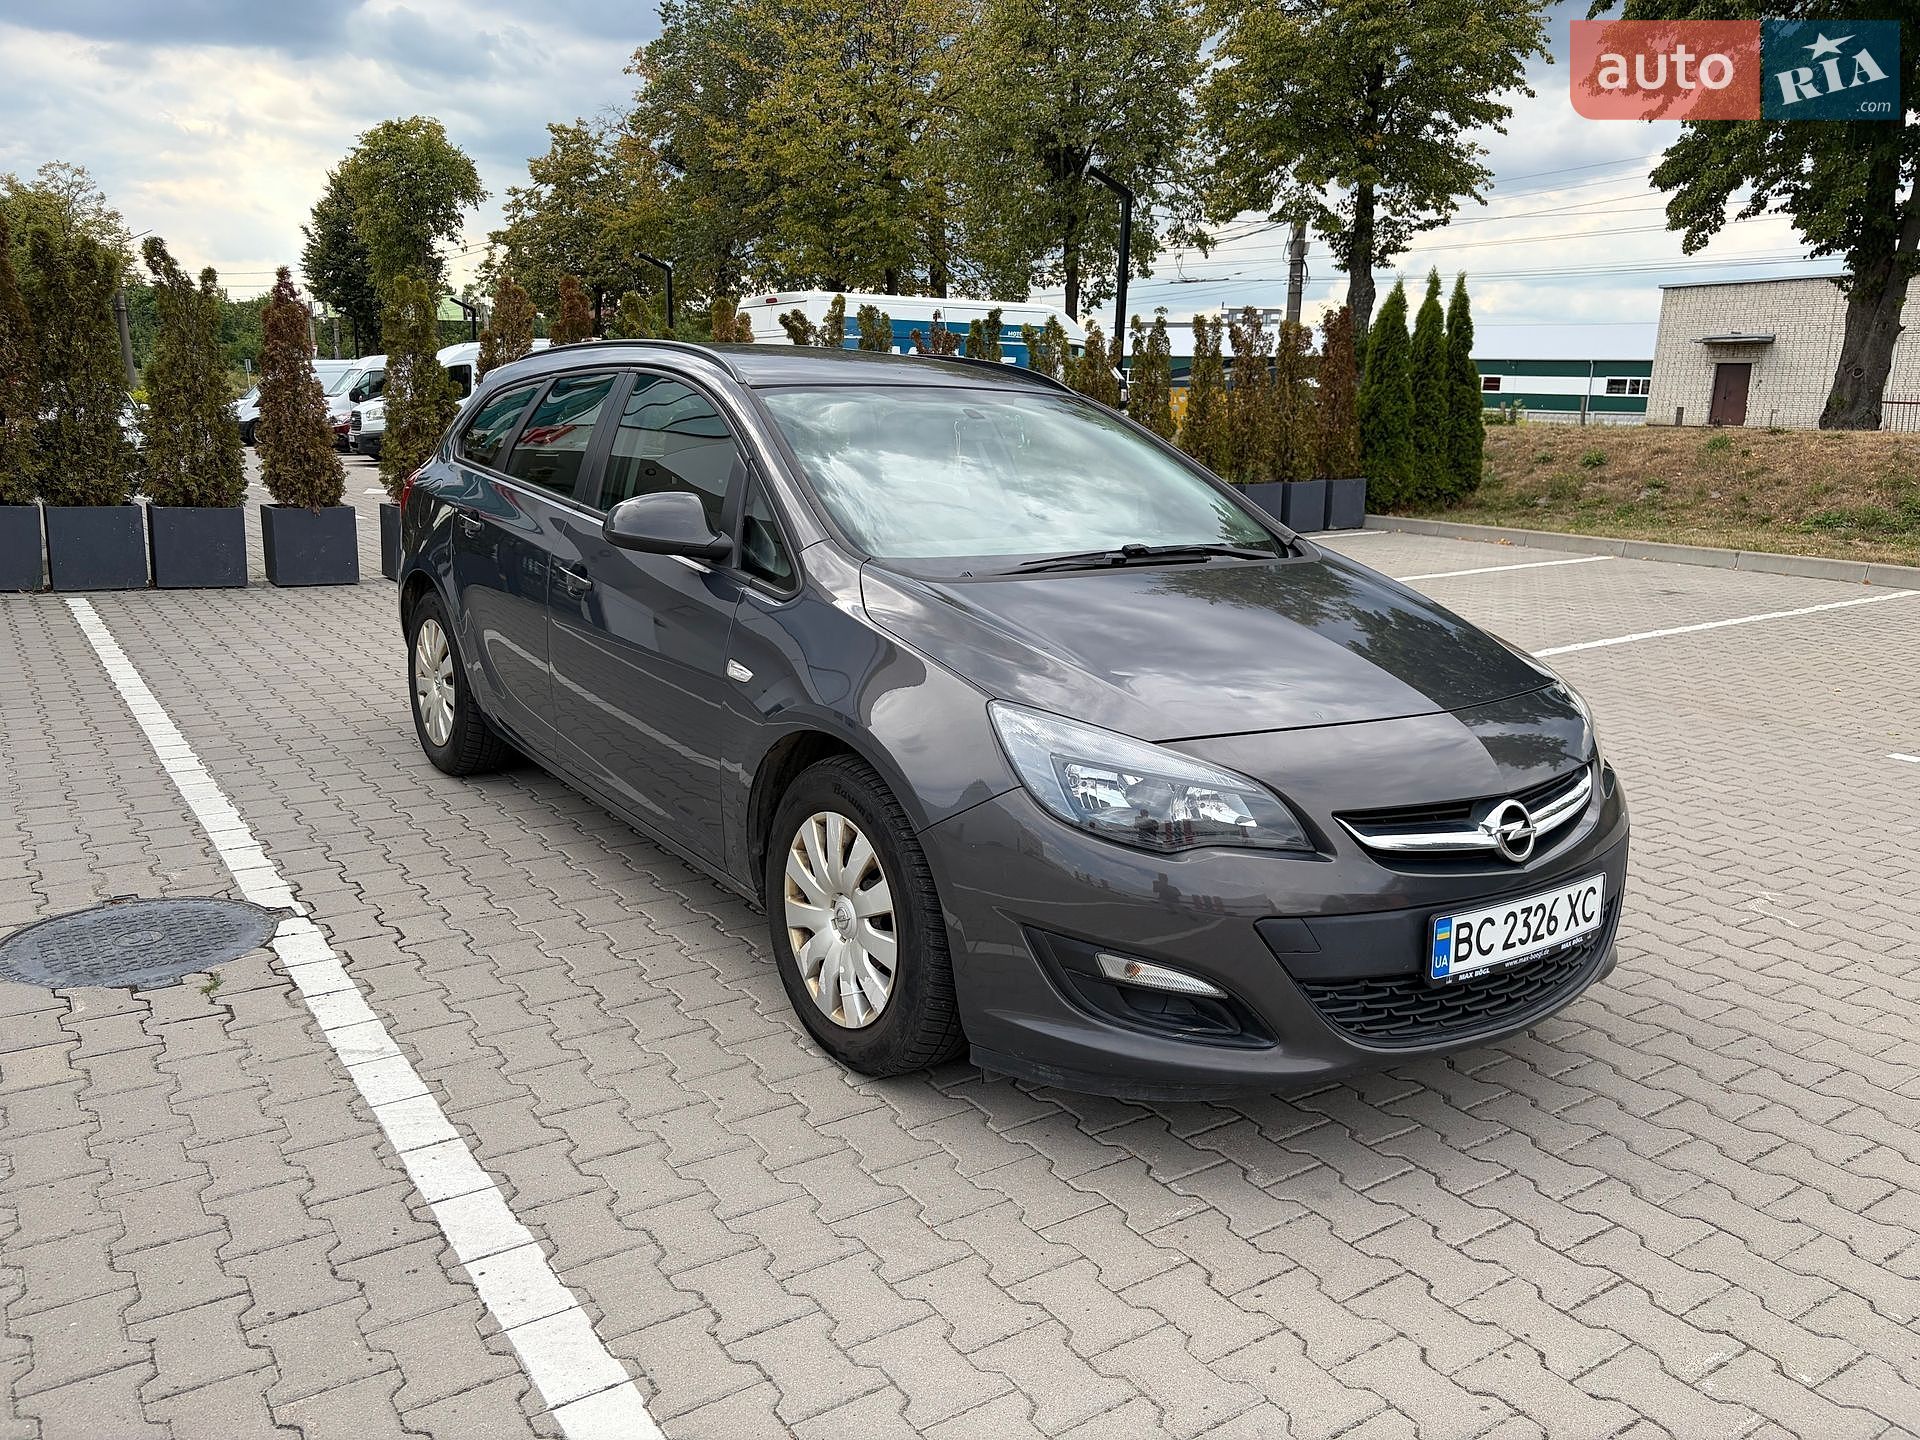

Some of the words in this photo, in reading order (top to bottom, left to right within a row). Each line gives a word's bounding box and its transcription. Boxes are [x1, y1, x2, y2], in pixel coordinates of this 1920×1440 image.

[1454, 917, 1496, 962] BC
[1502, 897, 1560, 951] 2326
[1565, 886, 1597, 931] XC
[1434, 955, 1448, 969] UA
[1458, 970, 1474, 981] MAX
